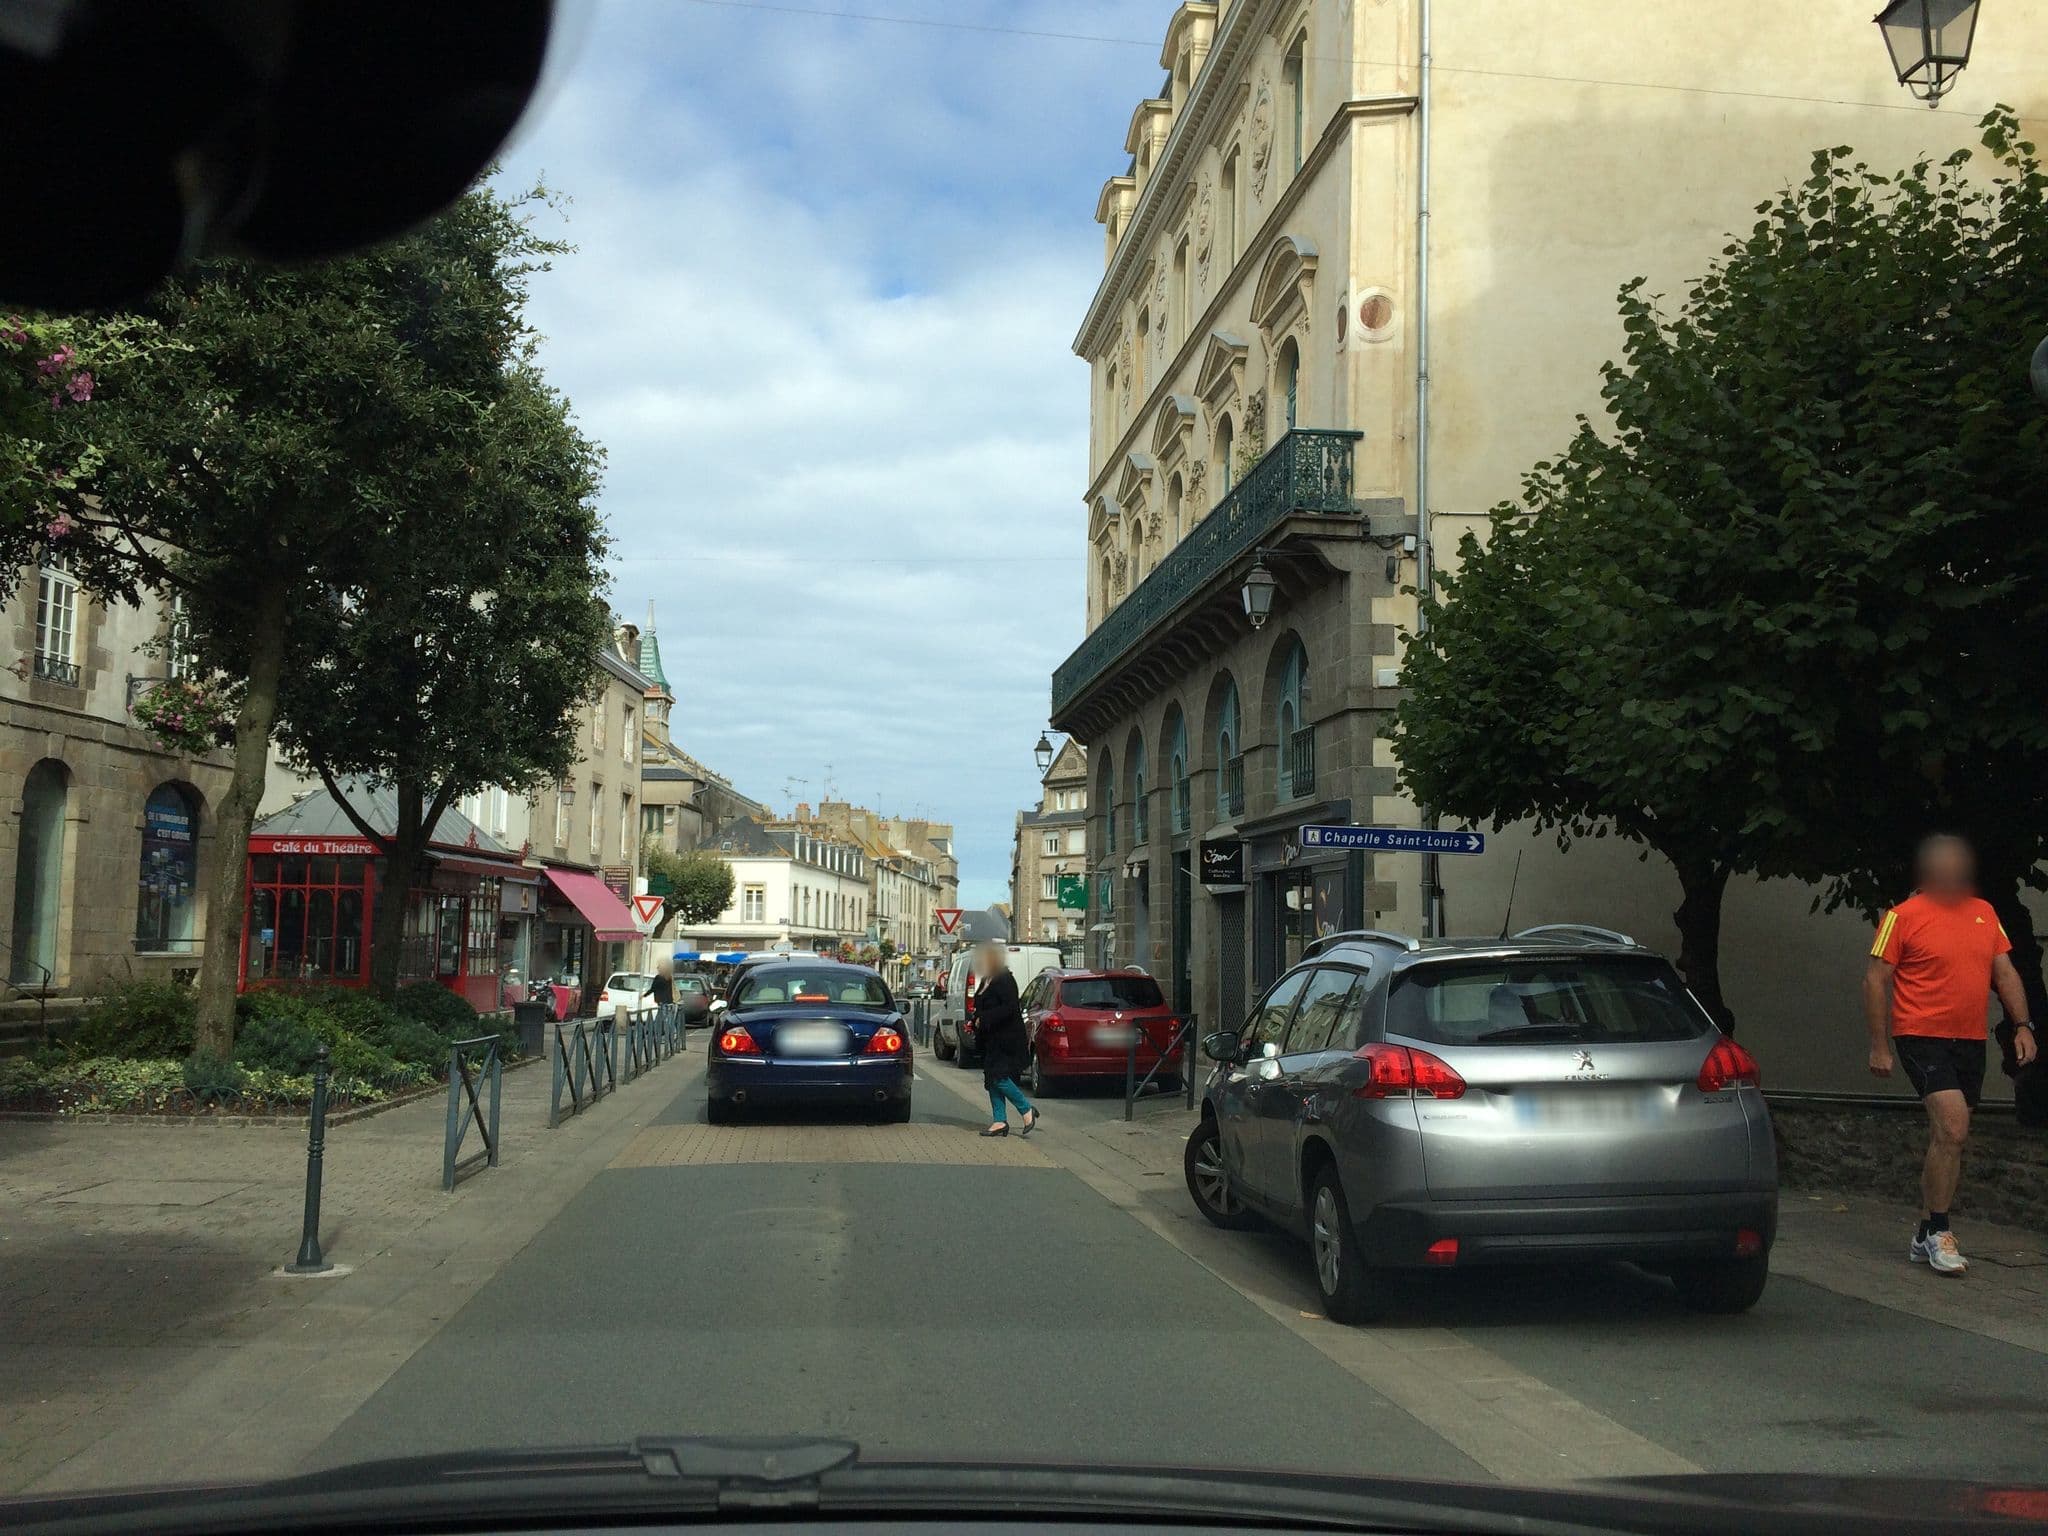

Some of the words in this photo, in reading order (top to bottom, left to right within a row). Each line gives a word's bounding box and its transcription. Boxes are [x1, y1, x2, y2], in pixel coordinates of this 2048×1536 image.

[1324, 831, 1380, 845] Chapelle
[1387, 834, 1460, 848] Saint-Louis
[272, 841, 300, 853] Café
[303, 841, 319, 853] du
[322, 842, 372, 854] Théâtre
